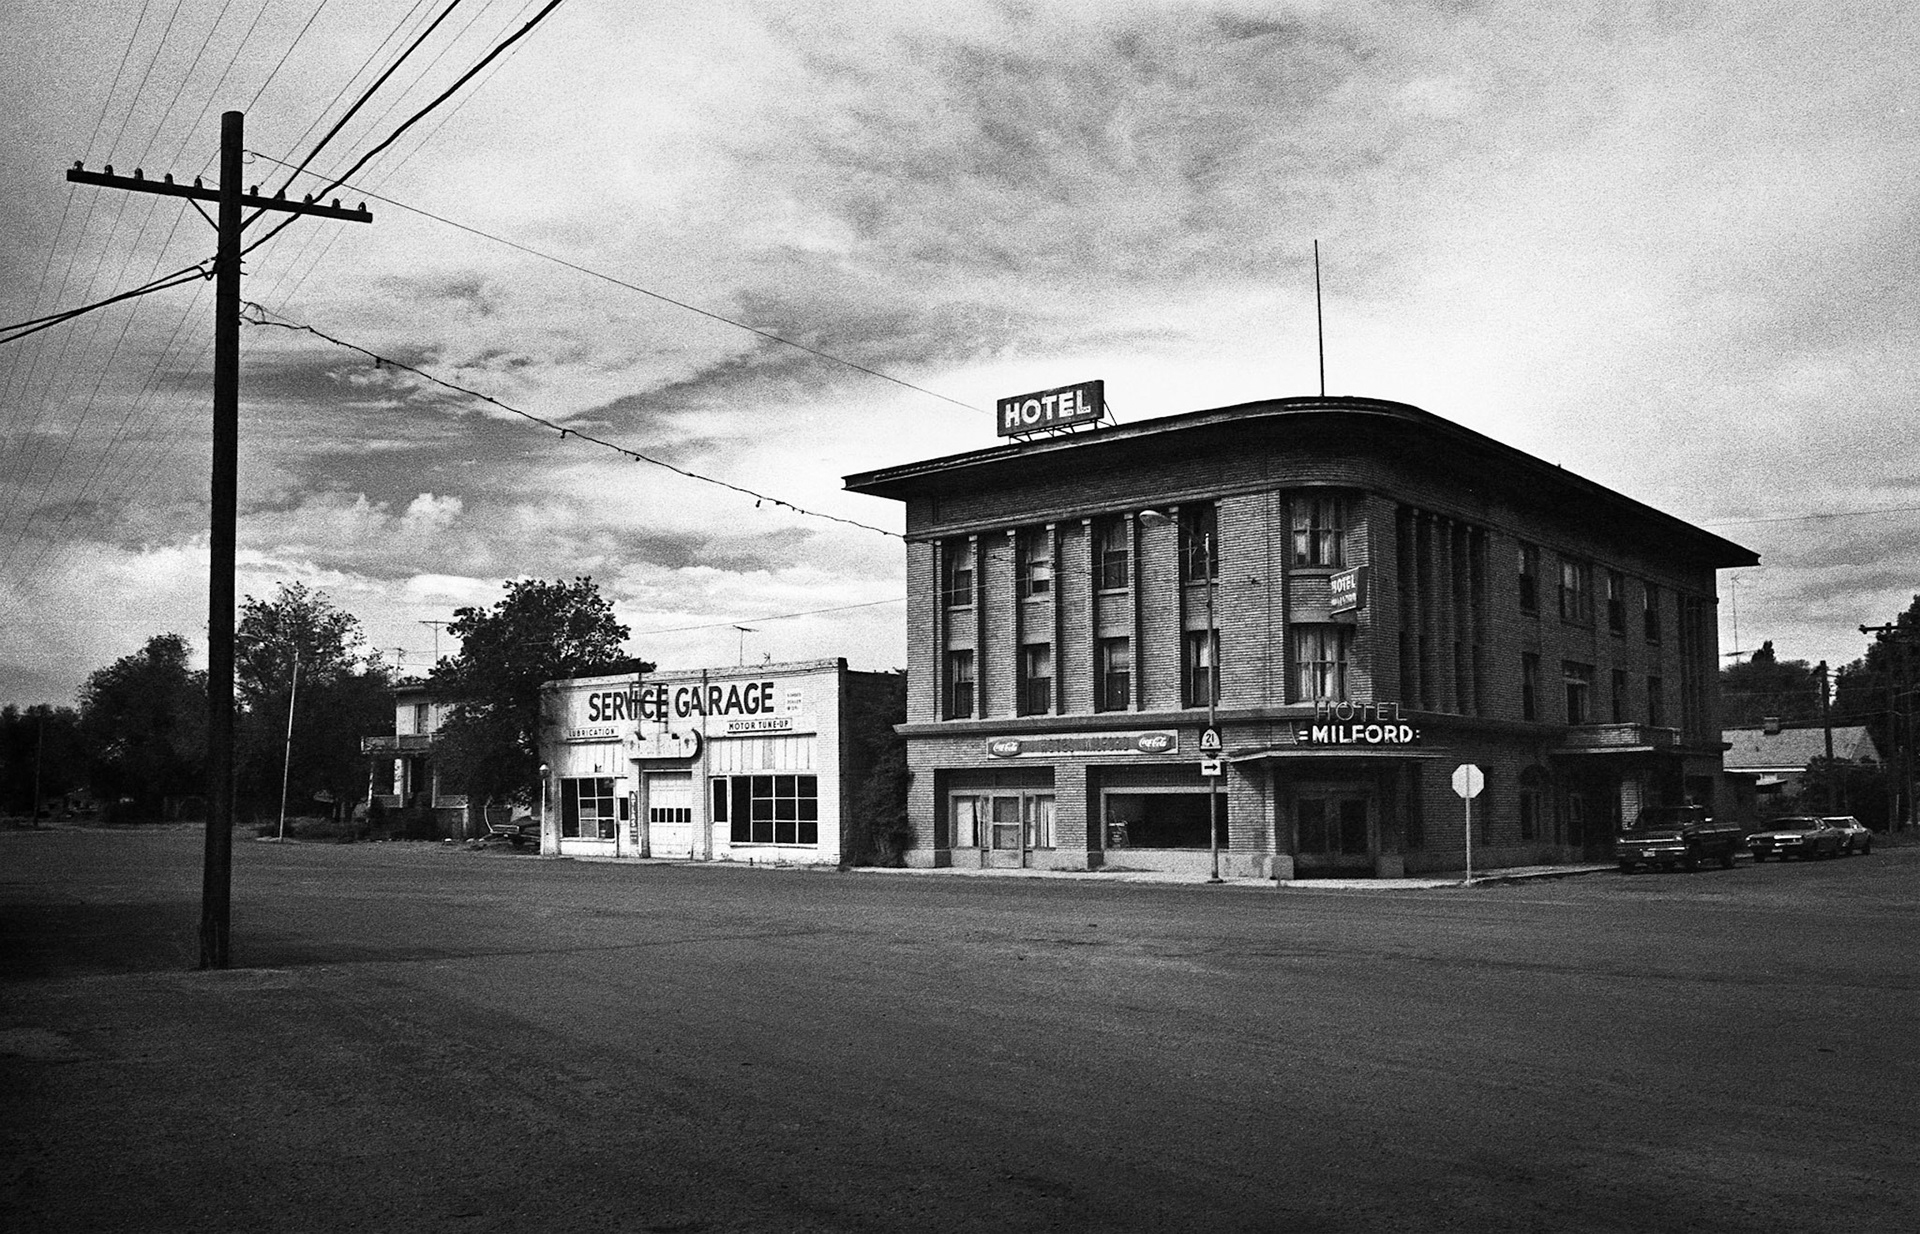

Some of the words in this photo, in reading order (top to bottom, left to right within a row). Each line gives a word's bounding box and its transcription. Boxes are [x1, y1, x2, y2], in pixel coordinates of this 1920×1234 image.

[1005, 389, 1091, 428] HOTEL
[1331, 574, 1356, 594] HOTEL
[588, 689, 668, 722] SERVICE
[675, 682, 774, 718] GARAGE
[1316, 701, 1407, 721] HOTEL
[569, 728, 615, 737] LUBRICATION
[728, 721, 756, 731] MOTOR
[758, 719, 789, 729] TUNE-UP
[1312, 724, 1413, 743] MILFORD
[1206, 733, 1215, 744] 21
